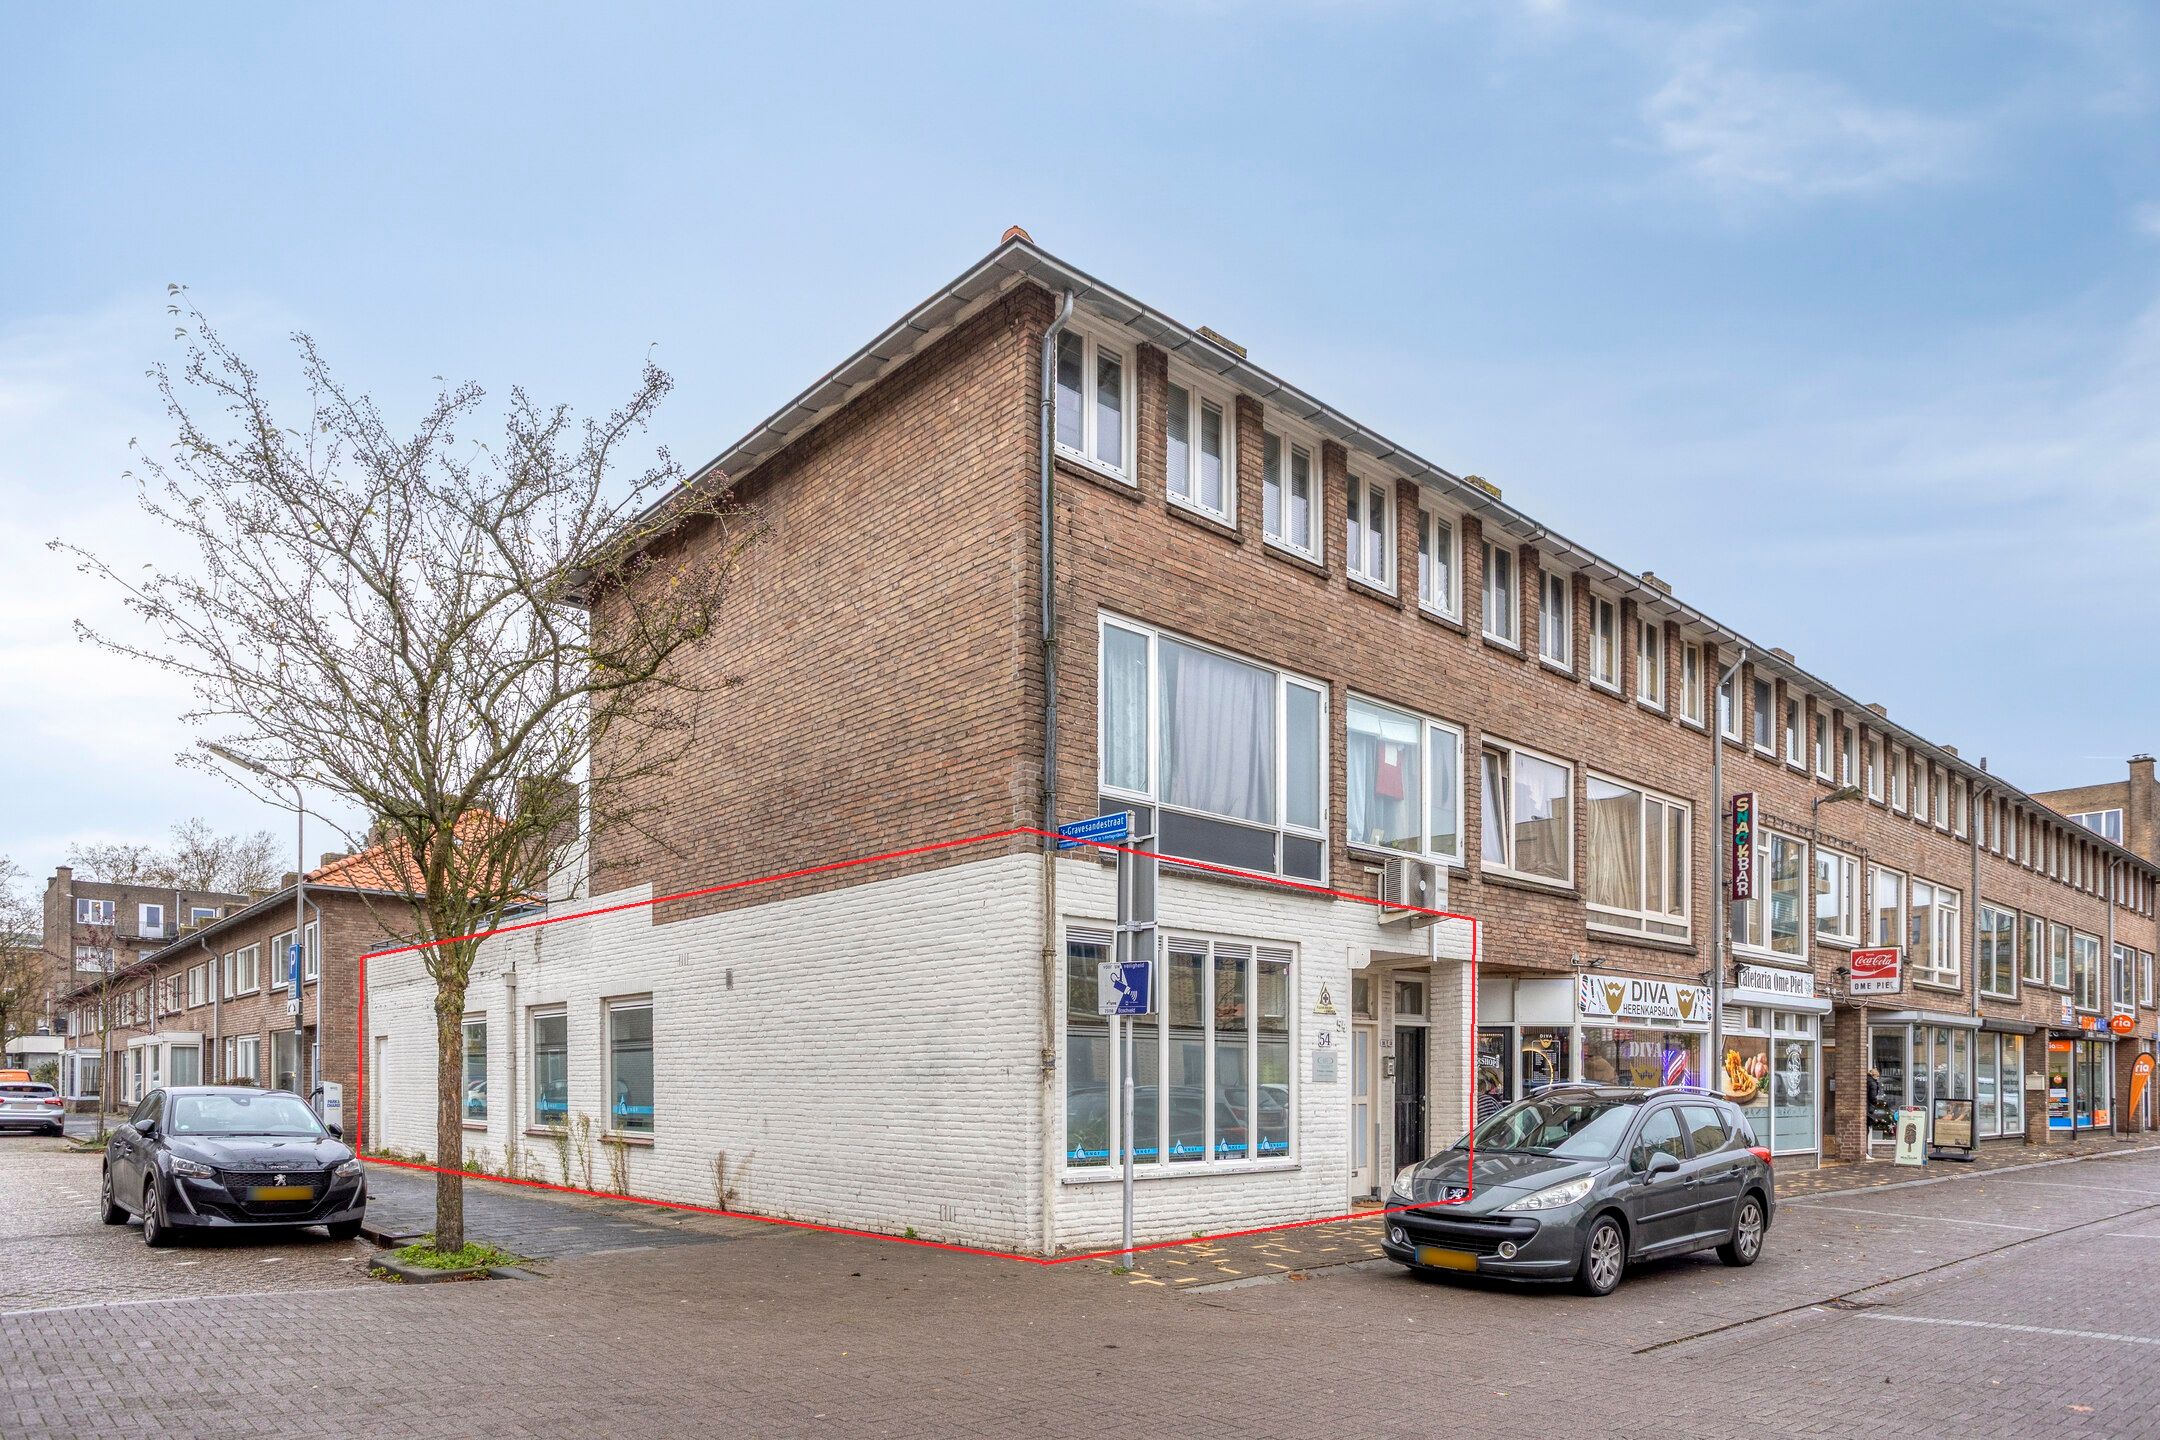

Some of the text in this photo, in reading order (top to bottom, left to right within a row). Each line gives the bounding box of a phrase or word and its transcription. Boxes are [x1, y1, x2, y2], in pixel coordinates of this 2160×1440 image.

[1060, 816, 1124, 836] 's-Gravesandestraat
[1735, 797, 1749, 897] SNACKBAR
[290, 950, 296, 974] P
[1854, 954, 1894, 967] Coca-Cola
[1739, 970, 1804, 994] Cafetaria Ome Piet
[1854, 982, 1872, 990] OME
[1631, 980, 1670, 1005] DIVA
[1622, 1003, 1679, 1018] HERENKAPSALON
[2113, 1017, 2131, 1027] ria
[1319, 1032, 1331, 1046] 54
[1629, 1041, 1663, 1058] DIVA
[2134, 1061, 2150, 1073] ria
